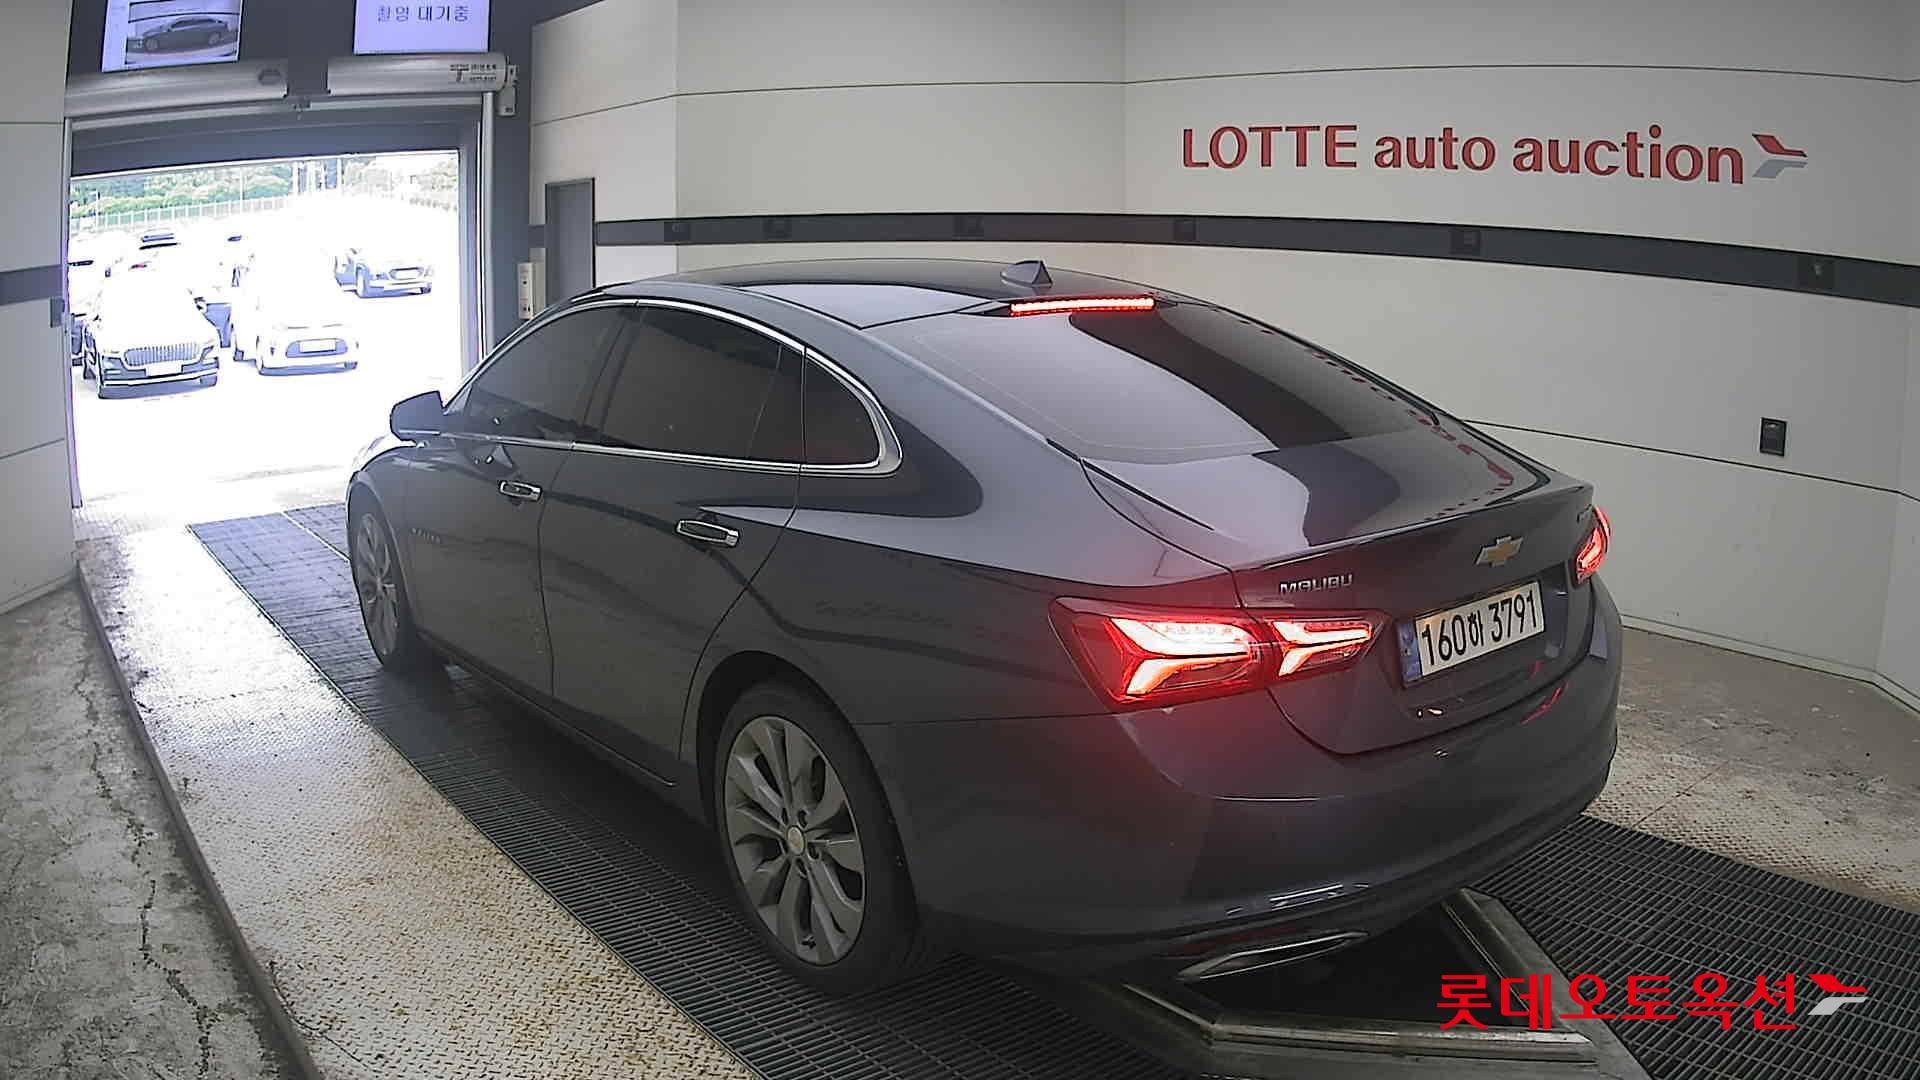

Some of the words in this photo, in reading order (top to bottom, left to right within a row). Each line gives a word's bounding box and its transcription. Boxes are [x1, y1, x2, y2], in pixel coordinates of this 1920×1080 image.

[418, 5, 472, 22] 대기중
[1183, 124, 1358, 169] LOTTE
[1374, 126, 1496, 171] auto
[1512, 124, 1744, 185] auction
[1279, 574, 1353, 593] MALIBU
[1421, 609, 1485, 666] 160하
[1488, 590, 1538, 643] 3791
